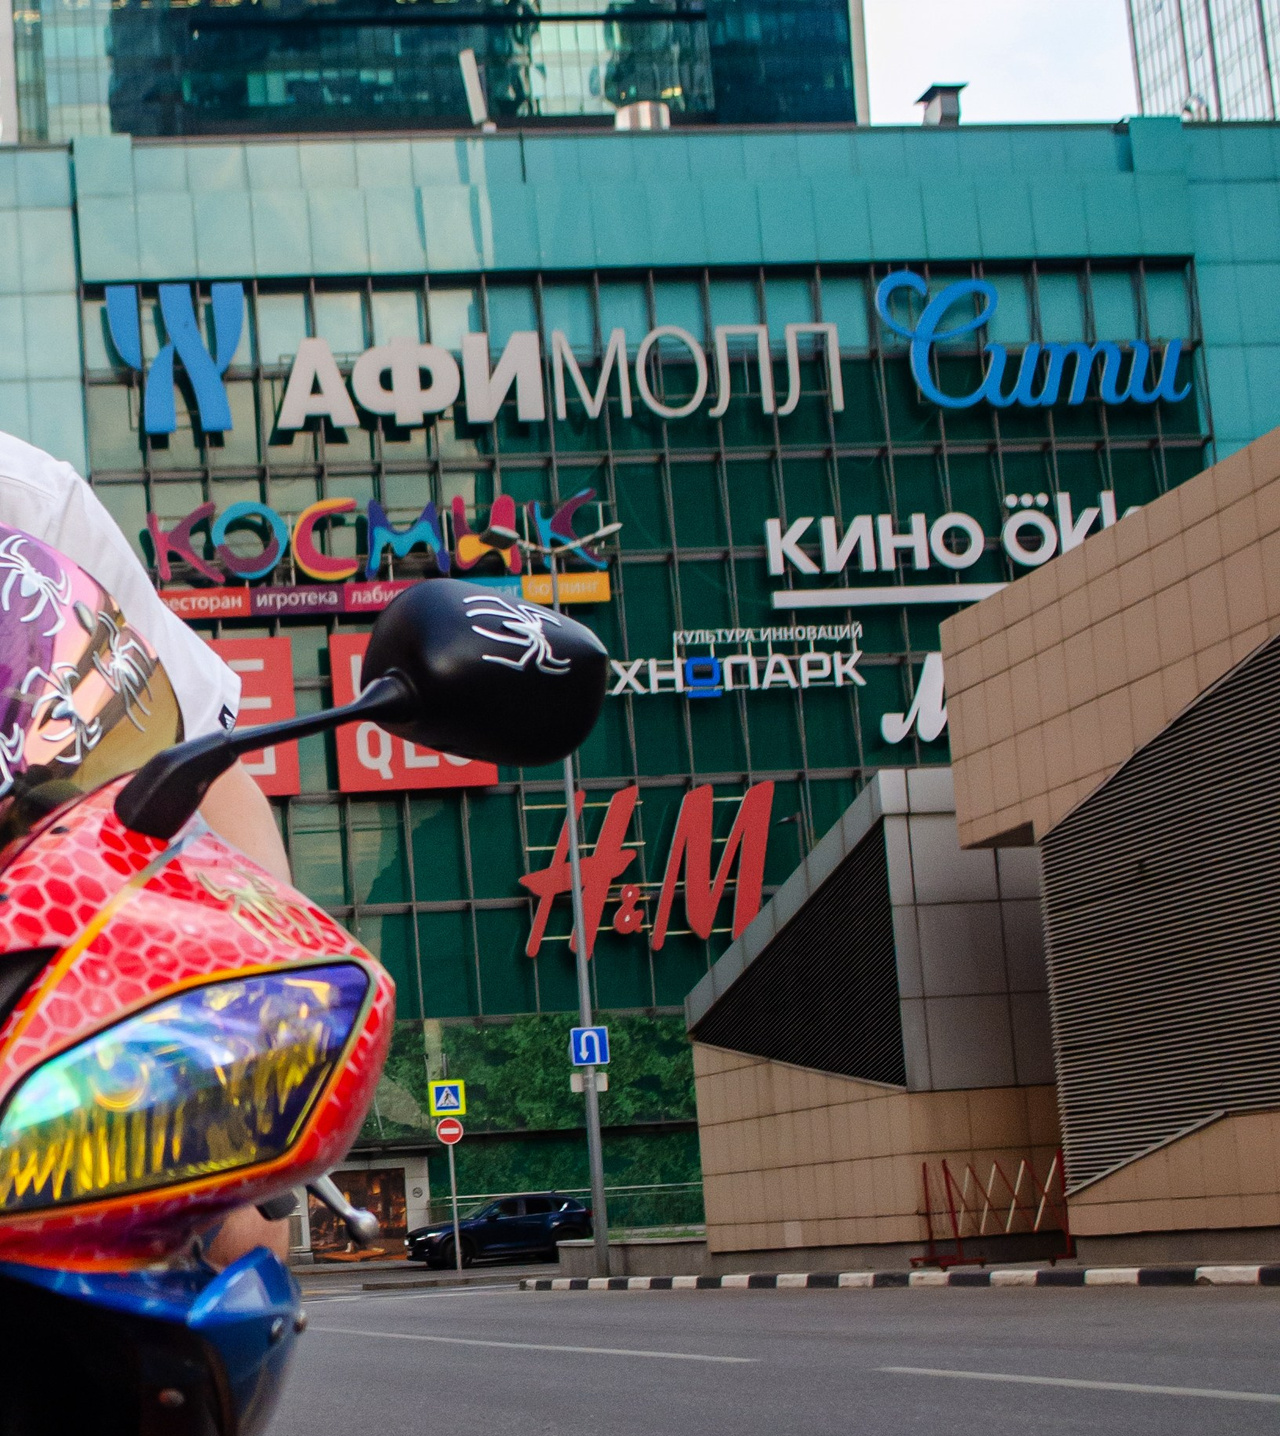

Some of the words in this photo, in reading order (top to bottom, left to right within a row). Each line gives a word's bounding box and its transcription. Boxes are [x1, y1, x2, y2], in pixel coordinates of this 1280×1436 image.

[277, 323, 845, 429] АФИМОЛЛ
[146, 488, 608, 583] КОСМИК
[764, 512, 986, 576] КИНО
[256, 590, 339, 611] игротека
[527, 579, 600, 598] болинг
[673, 628, 755, 645] КУЛЬТУРА
[759, 620, 863, 643] ИННОВАЦИЙ
[609, 649, 868, 698] ХНОПАРК
[518, 780, 773, 962] H&M
